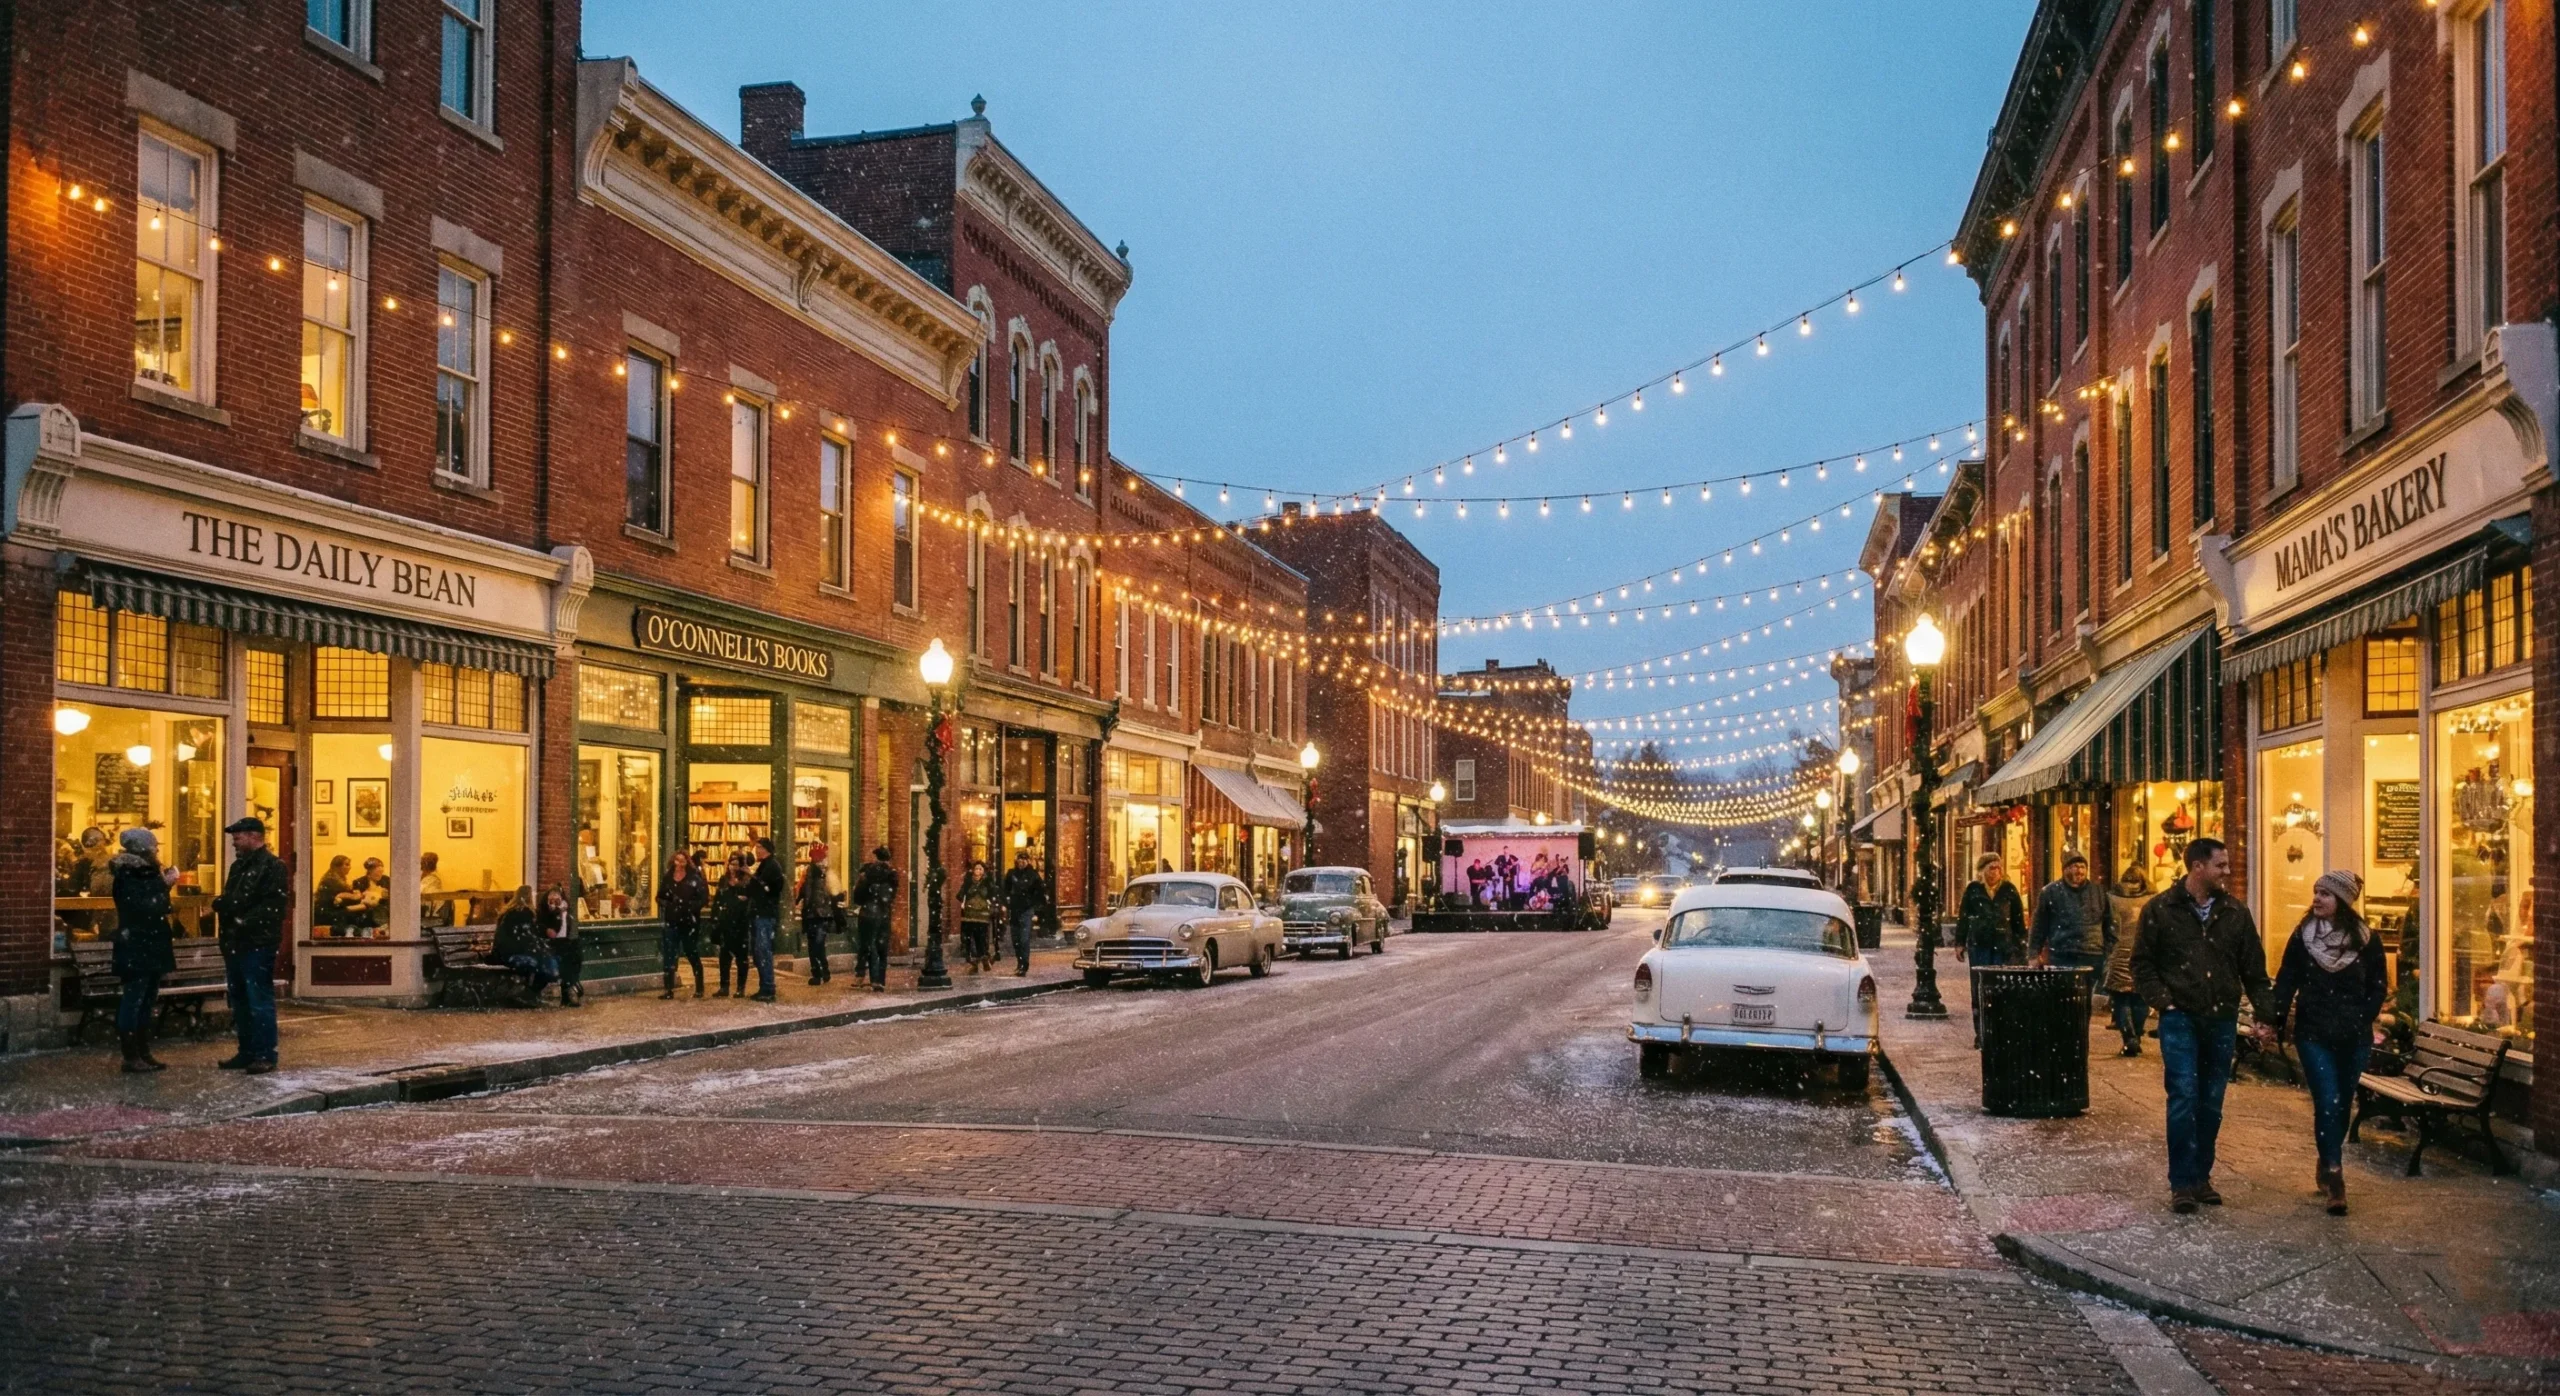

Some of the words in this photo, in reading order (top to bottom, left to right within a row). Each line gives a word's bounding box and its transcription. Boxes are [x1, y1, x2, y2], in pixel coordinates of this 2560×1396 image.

[182, 511, 264, 565] THE
[274, 532, 383, 588] DAILY
[392, 558, 476, 608] BEAN
[2274, 513, 2347, 592] MAMA'S
[2351, 452, 2447, 552] BAKERY
[648, 615, 769, 666] O'CONNELL'S
[773, 643, 828, 678] BOOKS
